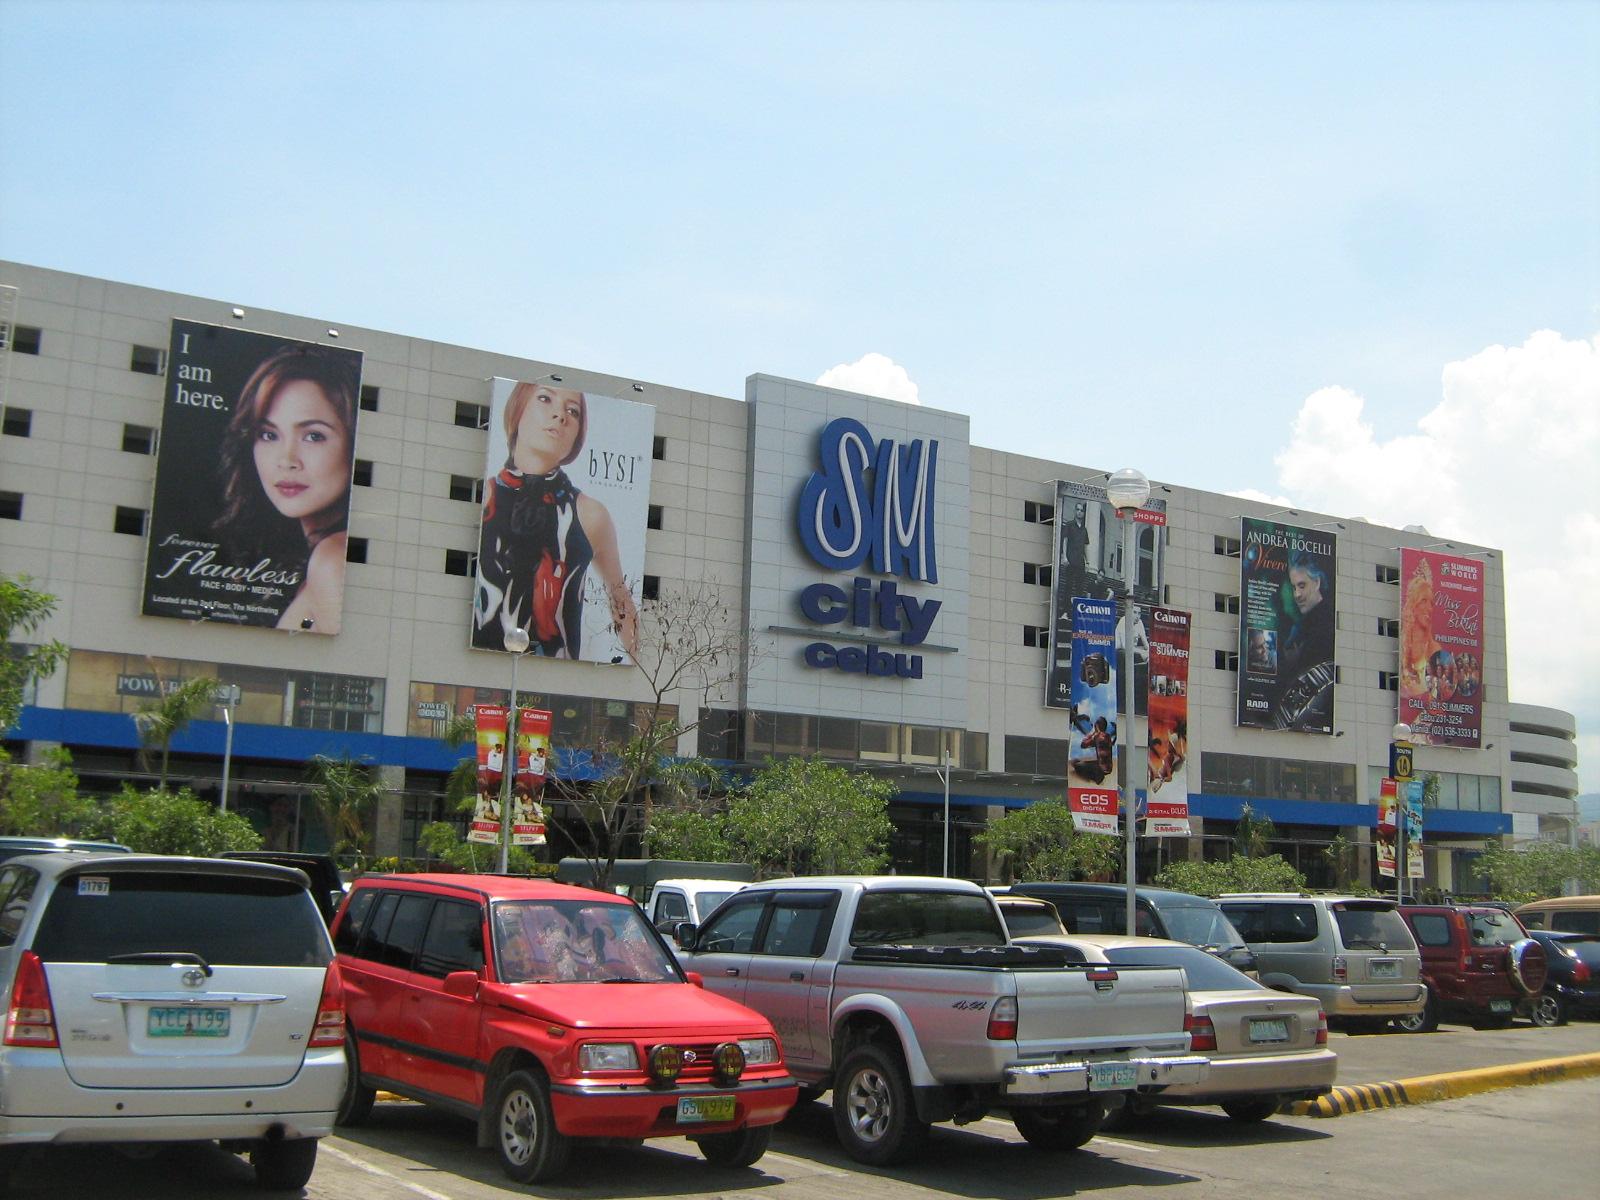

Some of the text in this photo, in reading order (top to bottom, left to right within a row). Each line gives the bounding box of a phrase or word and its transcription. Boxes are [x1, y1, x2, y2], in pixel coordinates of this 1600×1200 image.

[181, 333, 190, 354] I
[178, 364, 212, 383] am
[175, 383, 229, 411] here.
[798, 417, 940, 585] SM
[1246, 531, 1332, 556] ANDREA BOCELLI
[1450, 570, 1478, 580] WORLD
[200, 580, 283, 596] FACE BODY MEDICAL
[799, 576, 943, 646] city
[1077, 603, 1111, 616] Canon
[1154, 611, 1187, 624] Canon
[1156, 646, 1189, 659] SUMMER
[804, 642, 923, 679] cebu
[1246, 699, 1269, 709] RADO
[1408, 699, 1424, 709] CALL
[479, 707, 504, 716] Canon
[523, 711, 548, 721] Canon
[1080, 793, 1109, 806] EOS
